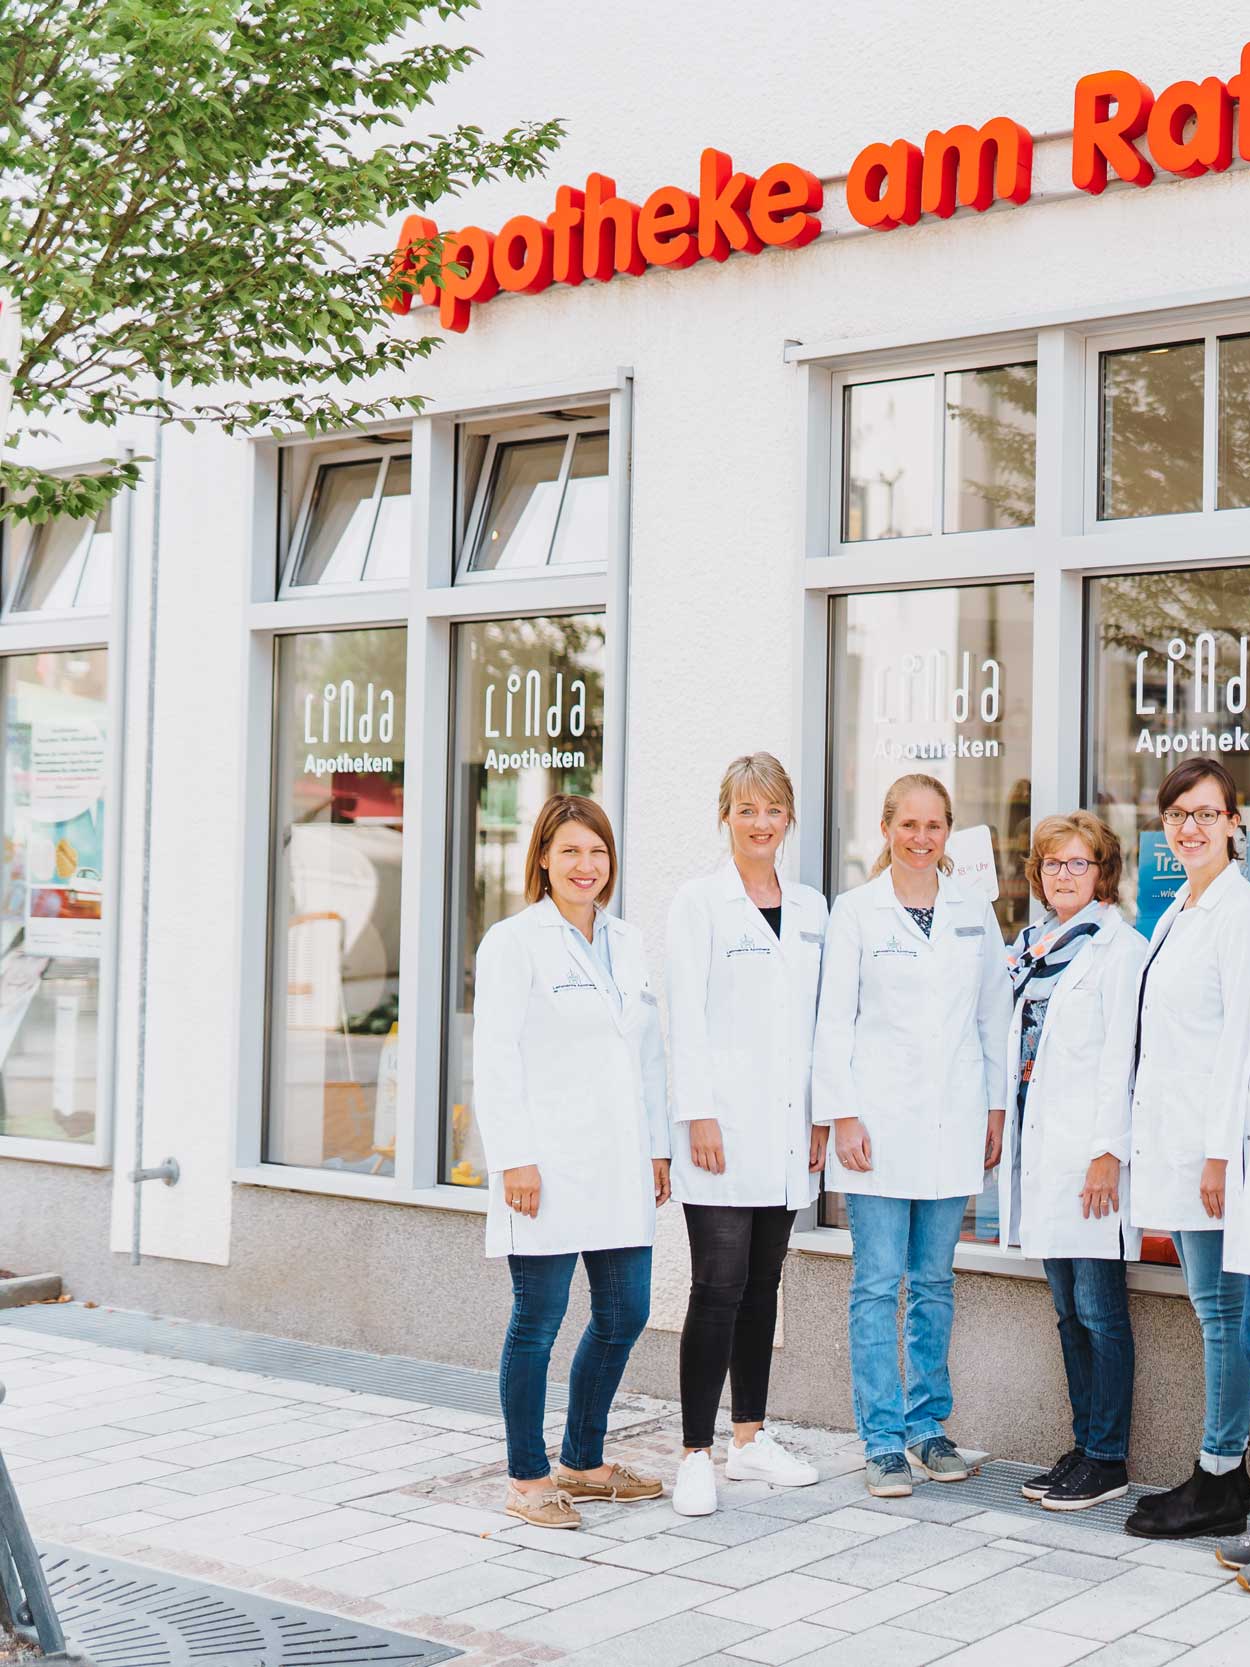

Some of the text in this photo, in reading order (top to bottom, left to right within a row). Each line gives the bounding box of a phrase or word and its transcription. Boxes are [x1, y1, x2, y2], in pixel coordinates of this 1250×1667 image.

[382, 147, 823, 333] Apotheke
[846, 116, 1034, 231] am
[484, 747, 585, 774] Apotheken
[873, 735, 1000, 762] Apotheken
[303, 752, 393, 778] Apotheken
